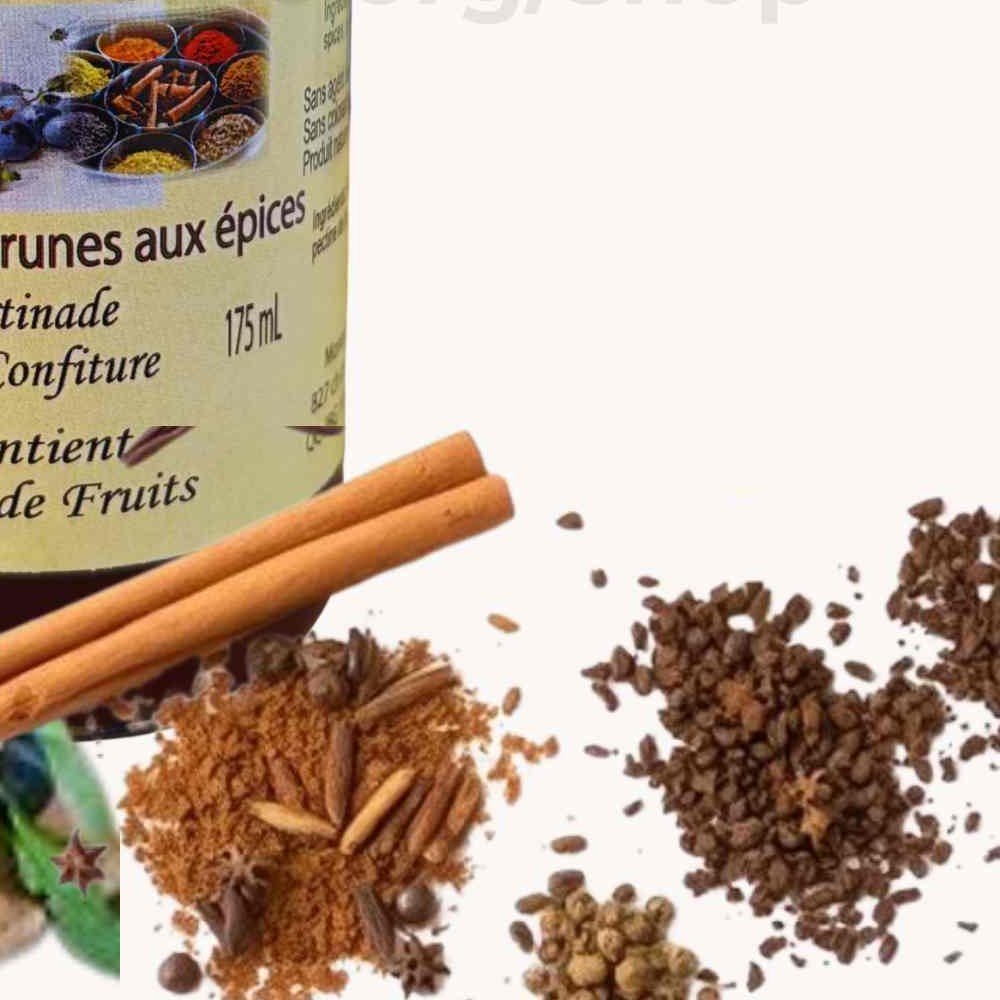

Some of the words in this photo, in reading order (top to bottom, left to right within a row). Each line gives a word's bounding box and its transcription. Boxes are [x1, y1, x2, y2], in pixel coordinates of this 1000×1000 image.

[303, 84, 327, 114] Sans
[302, 115, 327, 145] Sans
[134, 217, 207, 263] aux
[215, 187, 307, 259] épices
[224, 300, 255, 358] 175
[257, 291, 283, 346] mL
[62, 471, 200, 519] Fruits
